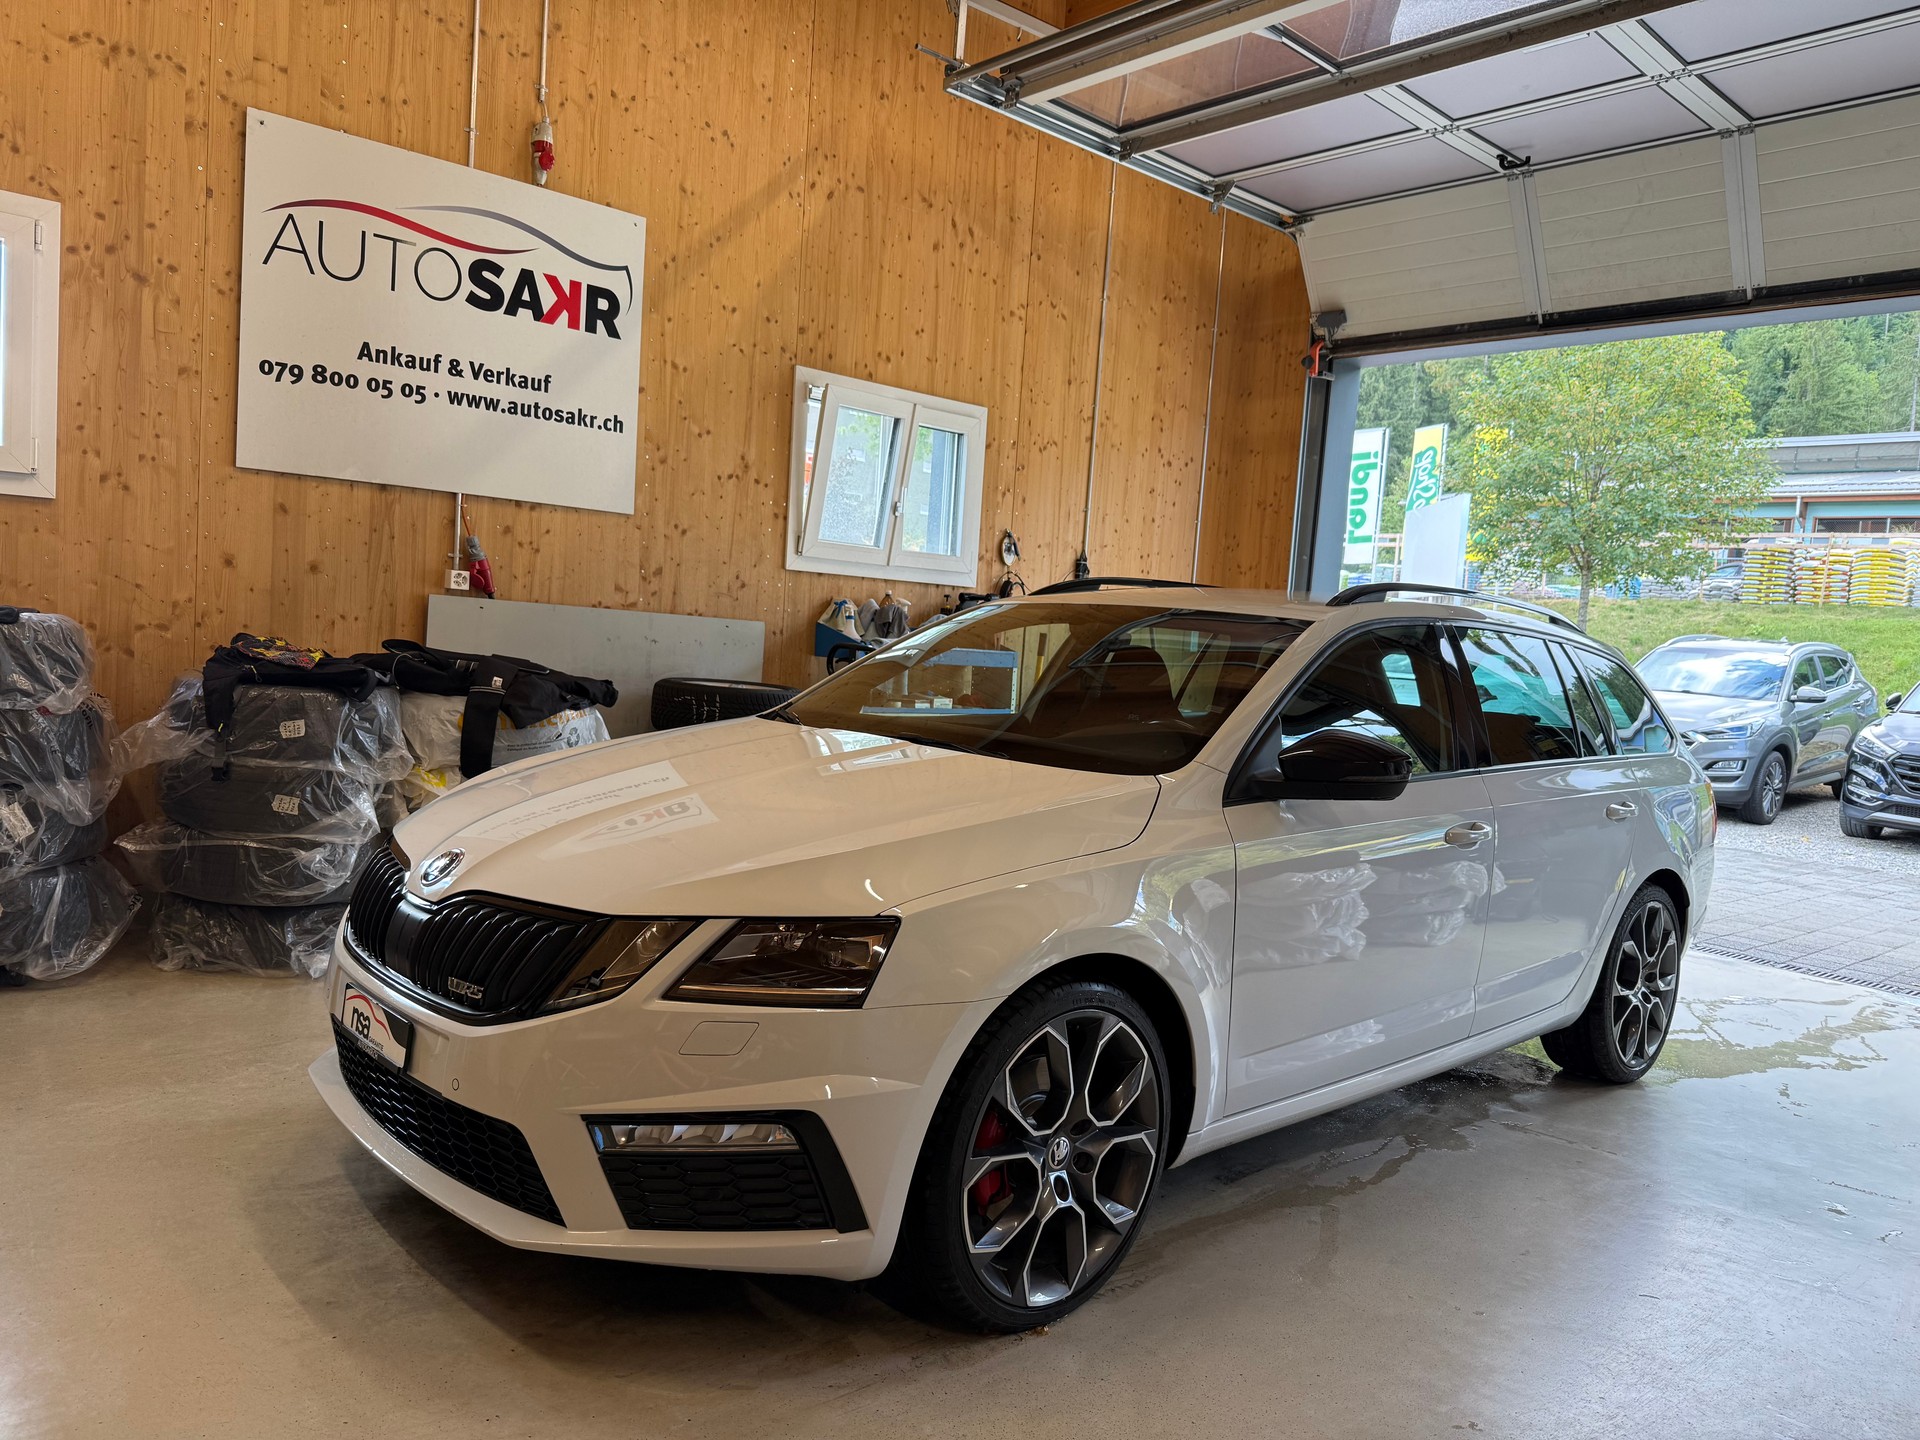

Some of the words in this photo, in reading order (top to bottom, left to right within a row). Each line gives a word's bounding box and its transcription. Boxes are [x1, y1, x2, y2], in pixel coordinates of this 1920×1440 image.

[262, 213, 621, 340] AUTOSAKR
[259, 359, 304, 385] 079
[311, 363, 359, 389] 800
[367, 377, 394, 399] 05
[400, 383, 427, 405] 05
[447, 391, 624, 434] www.autosakr.ch
[357, 342, 442, 374] Ankauf
[447, 359, 465, 378] &
[469, 361, 552, 393] Verkauf
[350, 1006, 371, 1040] nsa
